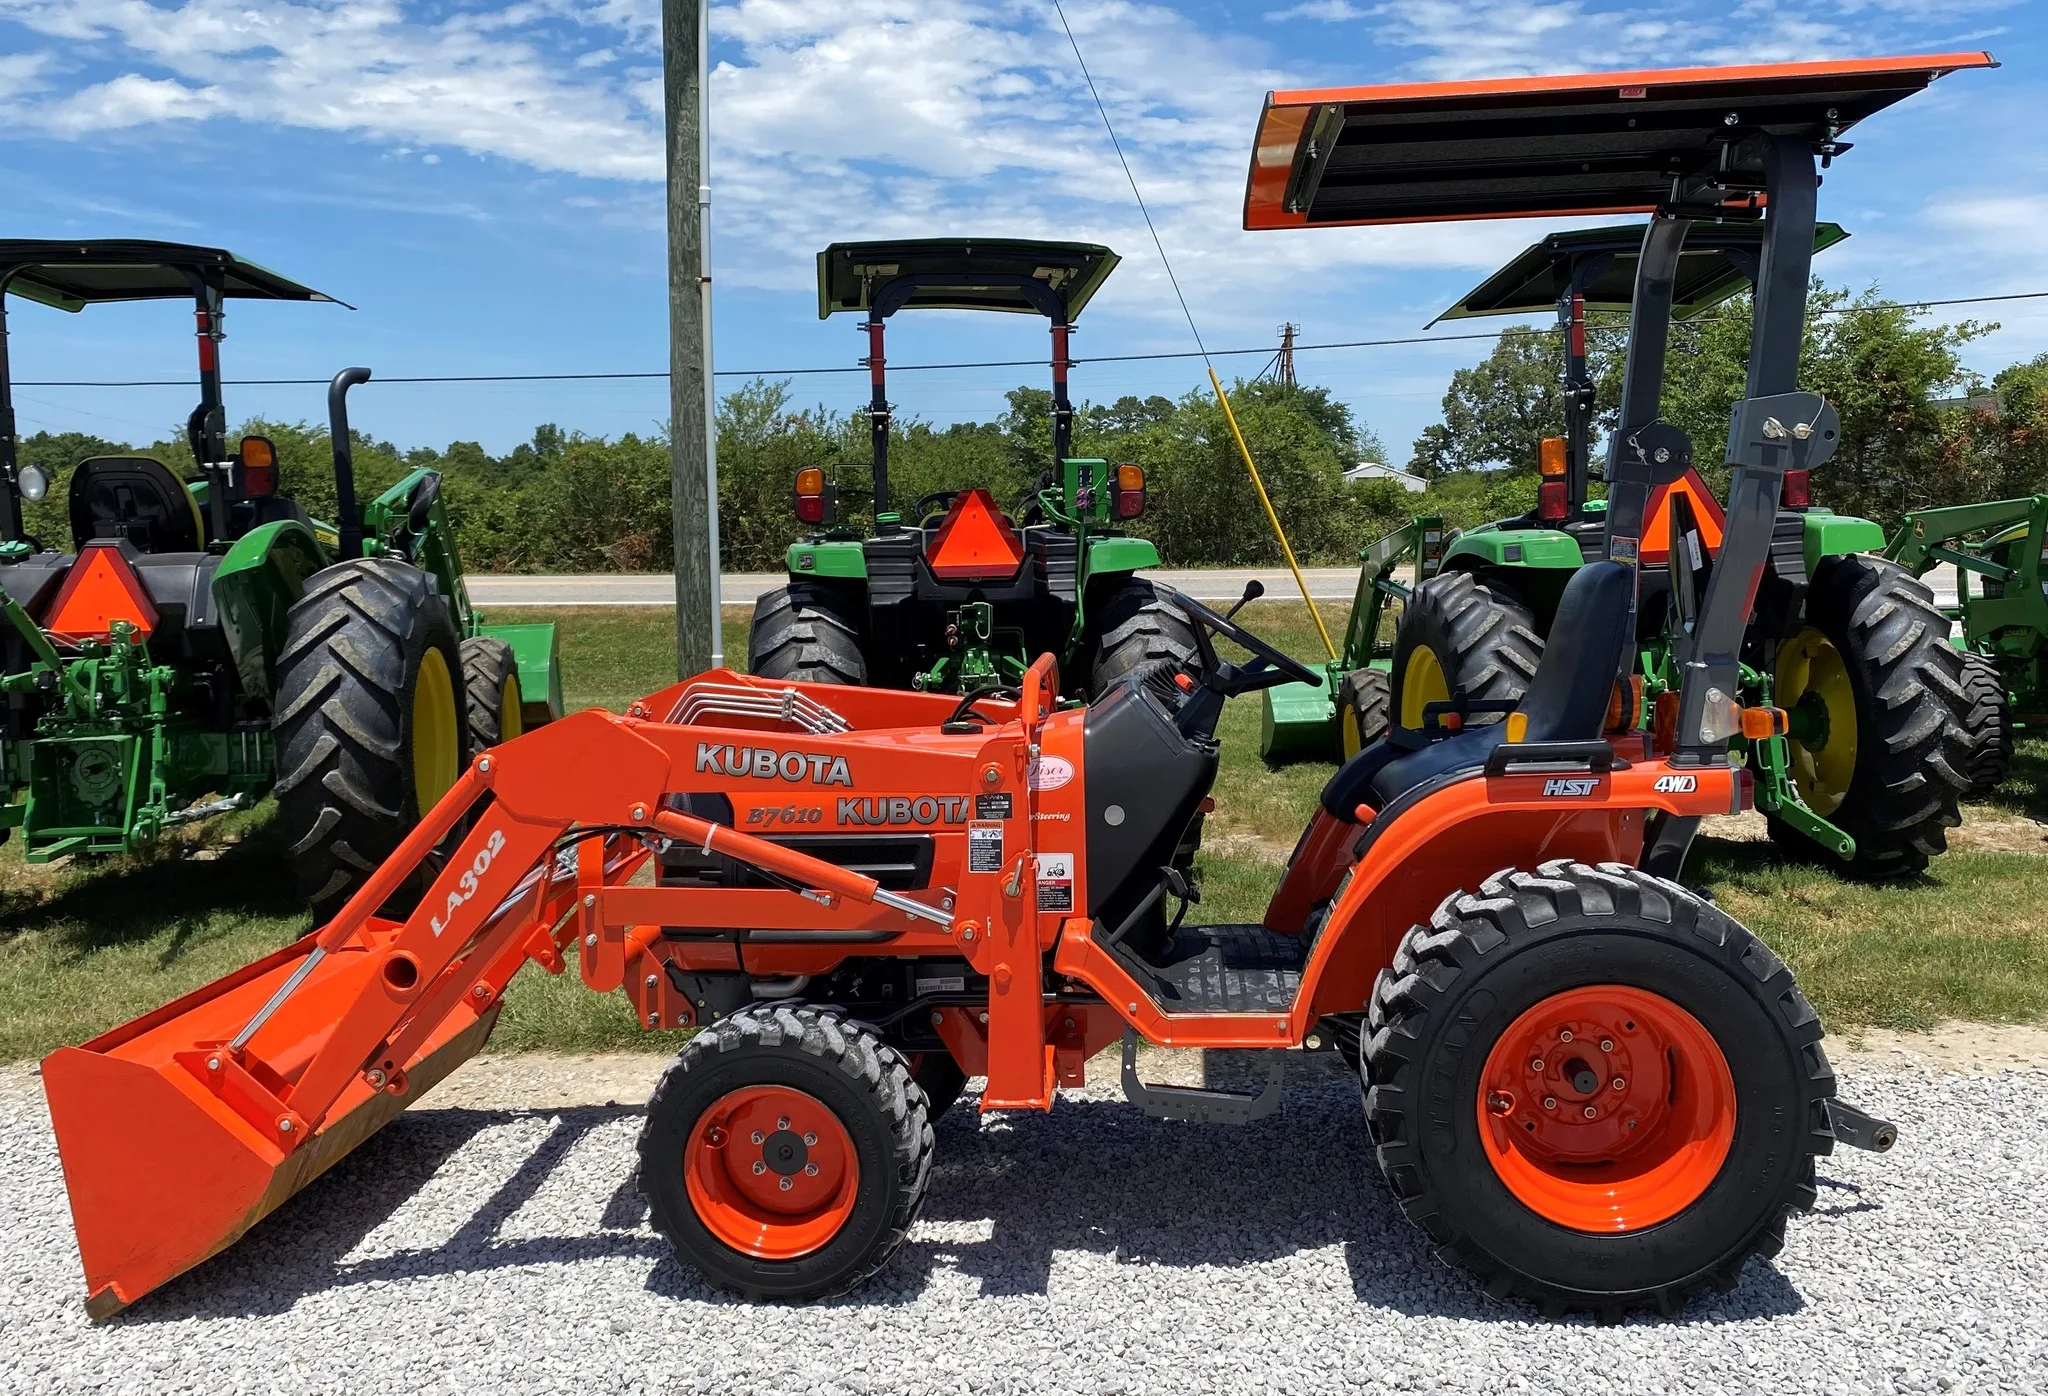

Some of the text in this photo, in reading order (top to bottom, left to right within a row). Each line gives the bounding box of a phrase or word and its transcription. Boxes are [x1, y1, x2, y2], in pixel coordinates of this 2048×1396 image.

[695, 742, 854, 788] KUBOTA
[1542, 779, 1600, 796] HST
[1653, 775, 1698, 793] 4WD
[746, 805, 823, 828] B7610
[430, 829, 506, 938] LA302
